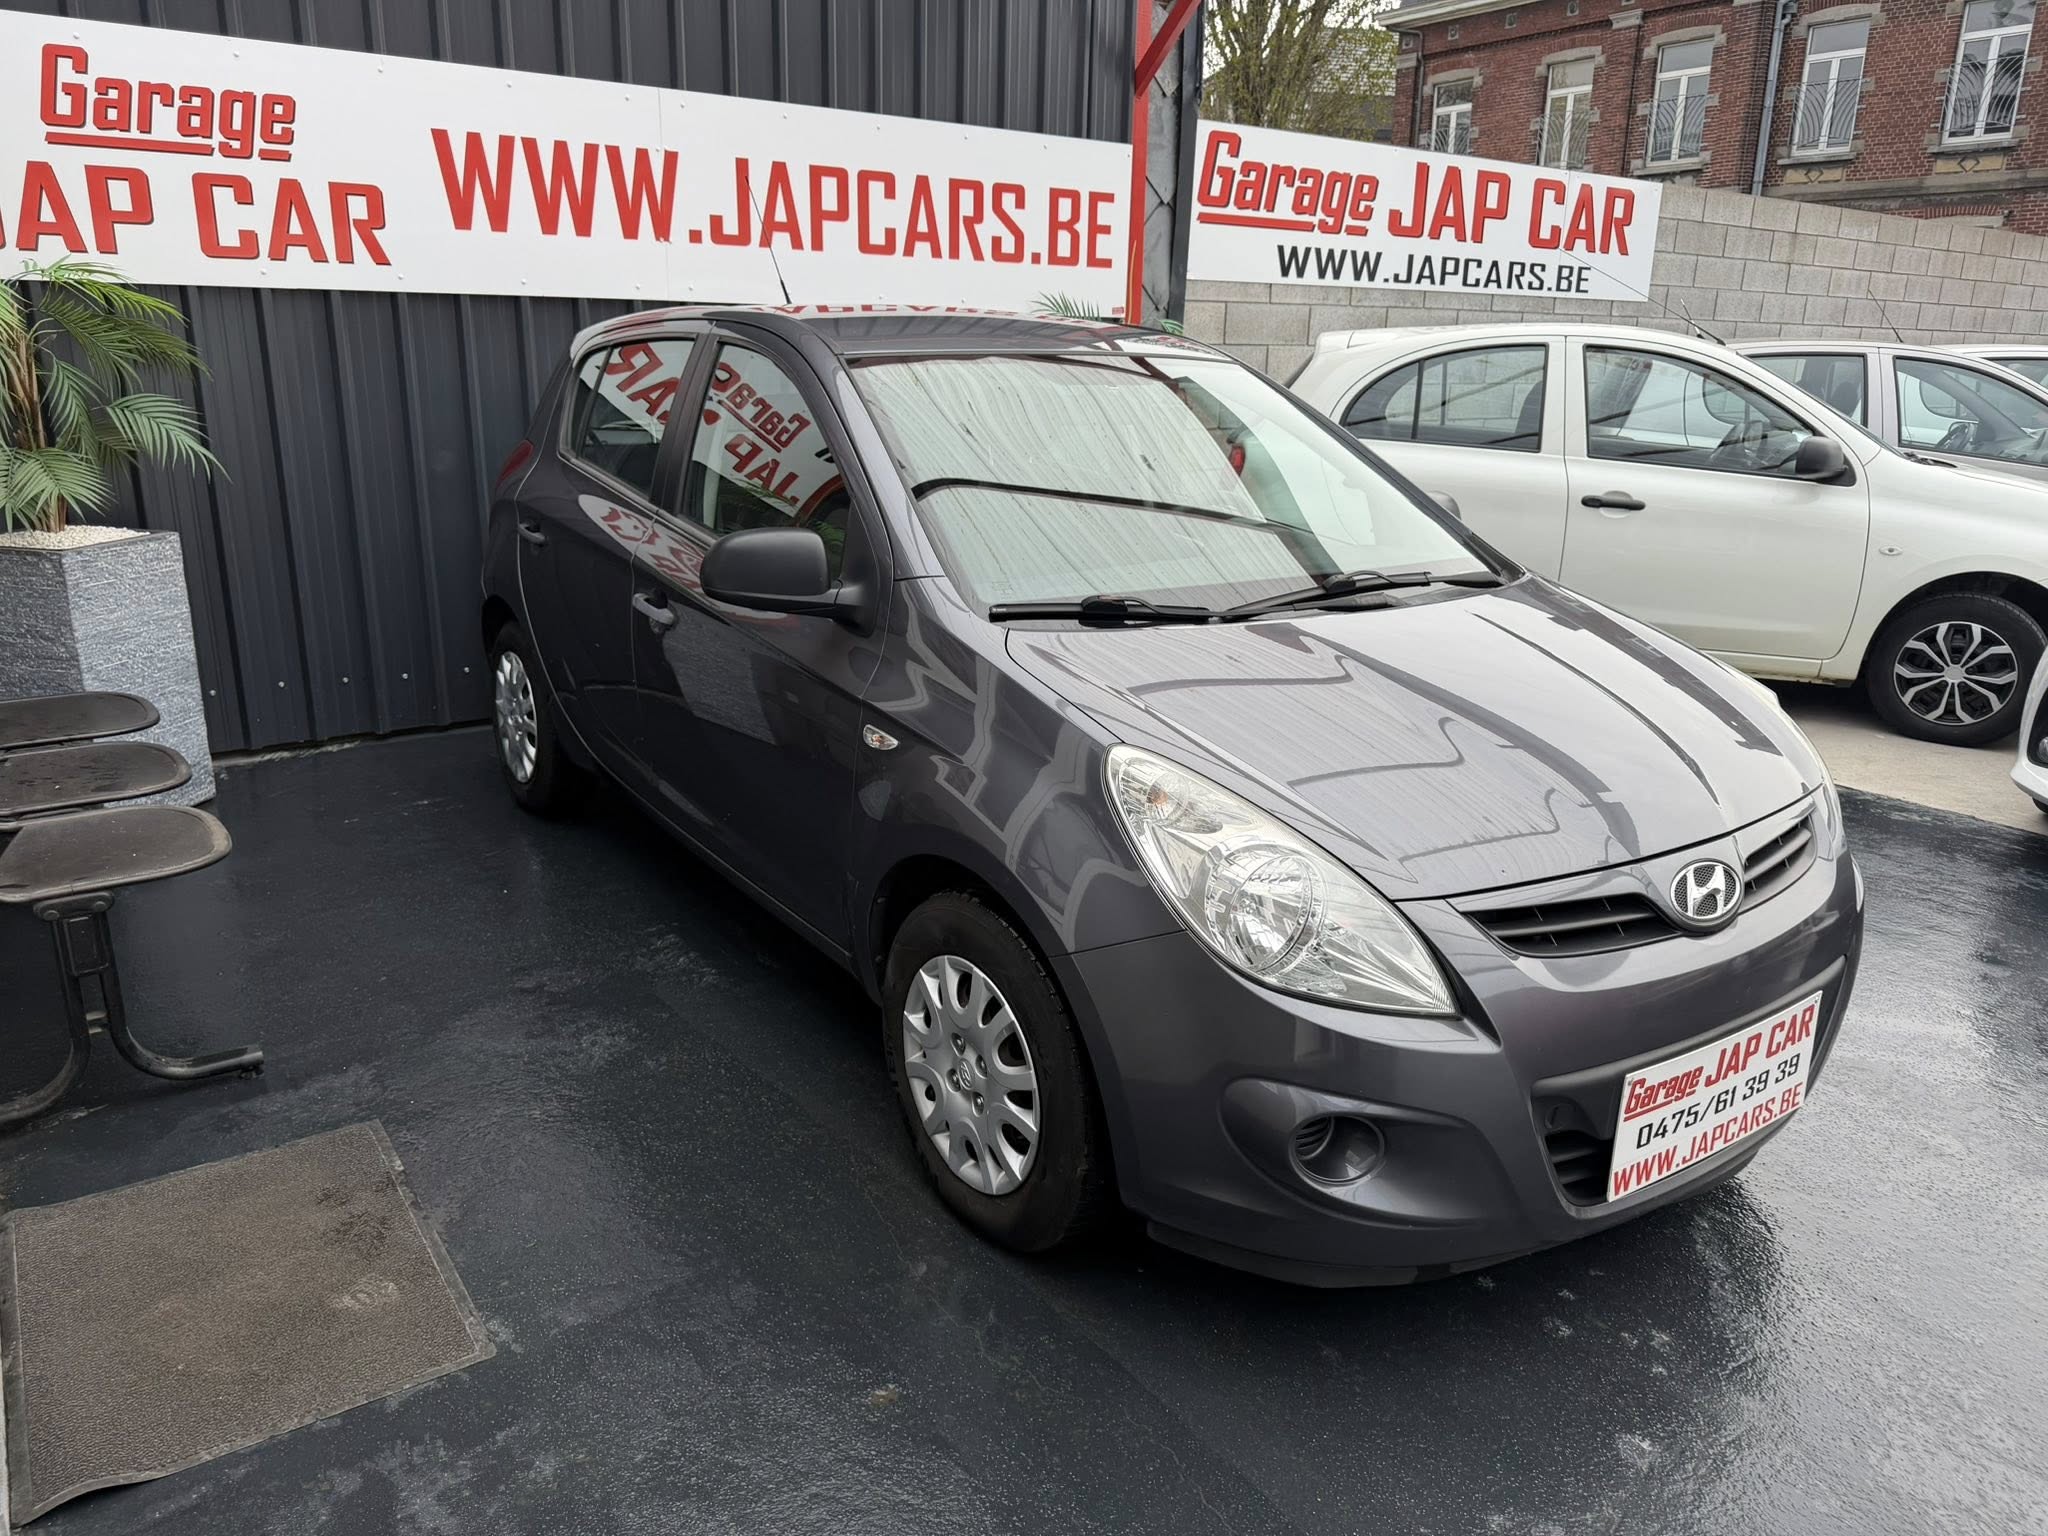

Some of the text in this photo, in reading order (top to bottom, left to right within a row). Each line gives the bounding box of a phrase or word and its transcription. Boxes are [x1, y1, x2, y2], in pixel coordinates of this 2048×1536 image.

[40, 43, 296, 159] Garage
[0, 160, 391, 266] AP CAR
[430, 127, 1117, 270] WWW.JAPCARS.BE
[1196, 129, 1636, 257] Garage JAP CAR
[1276, 244, 1592, 294] WWW.JAPCARS.BE
[1624, 1003, 1815, 1117] Garage JAP CAR
[1636, 1052, 1801, 1150] 0475/61 39 39
[1613, 1082, 1804, 1197] WWW.JAPCARS.BE
